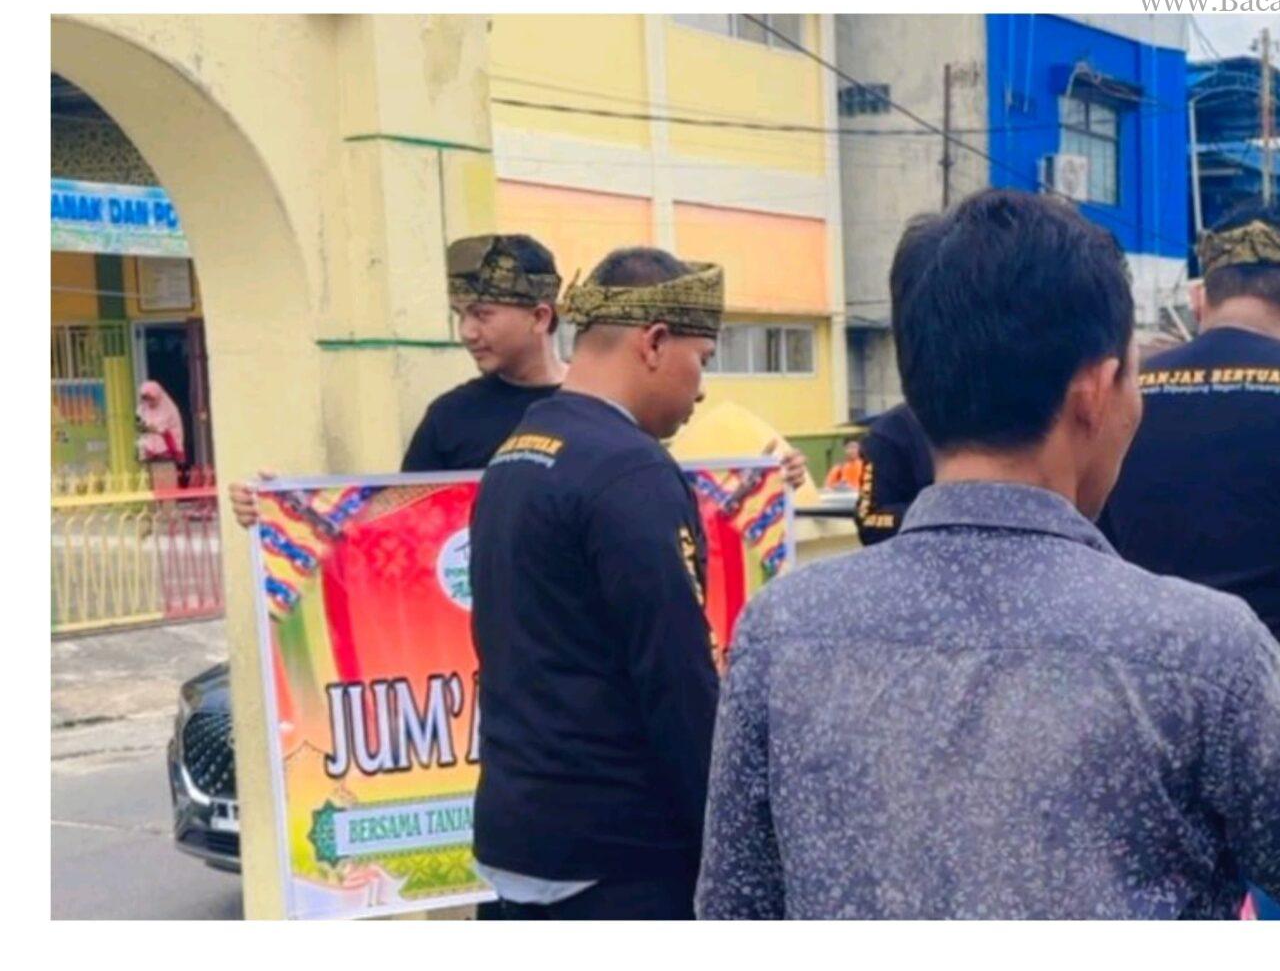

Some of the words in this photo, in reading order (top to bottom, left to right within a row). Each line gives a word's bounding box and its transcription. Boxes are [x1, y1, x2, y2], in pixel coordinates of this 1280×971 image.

[108, 197, 149, 225] DAN
[1138, 369, 1206, 386] TANJAK
[348, 811, 421, 844] BERSAMA
